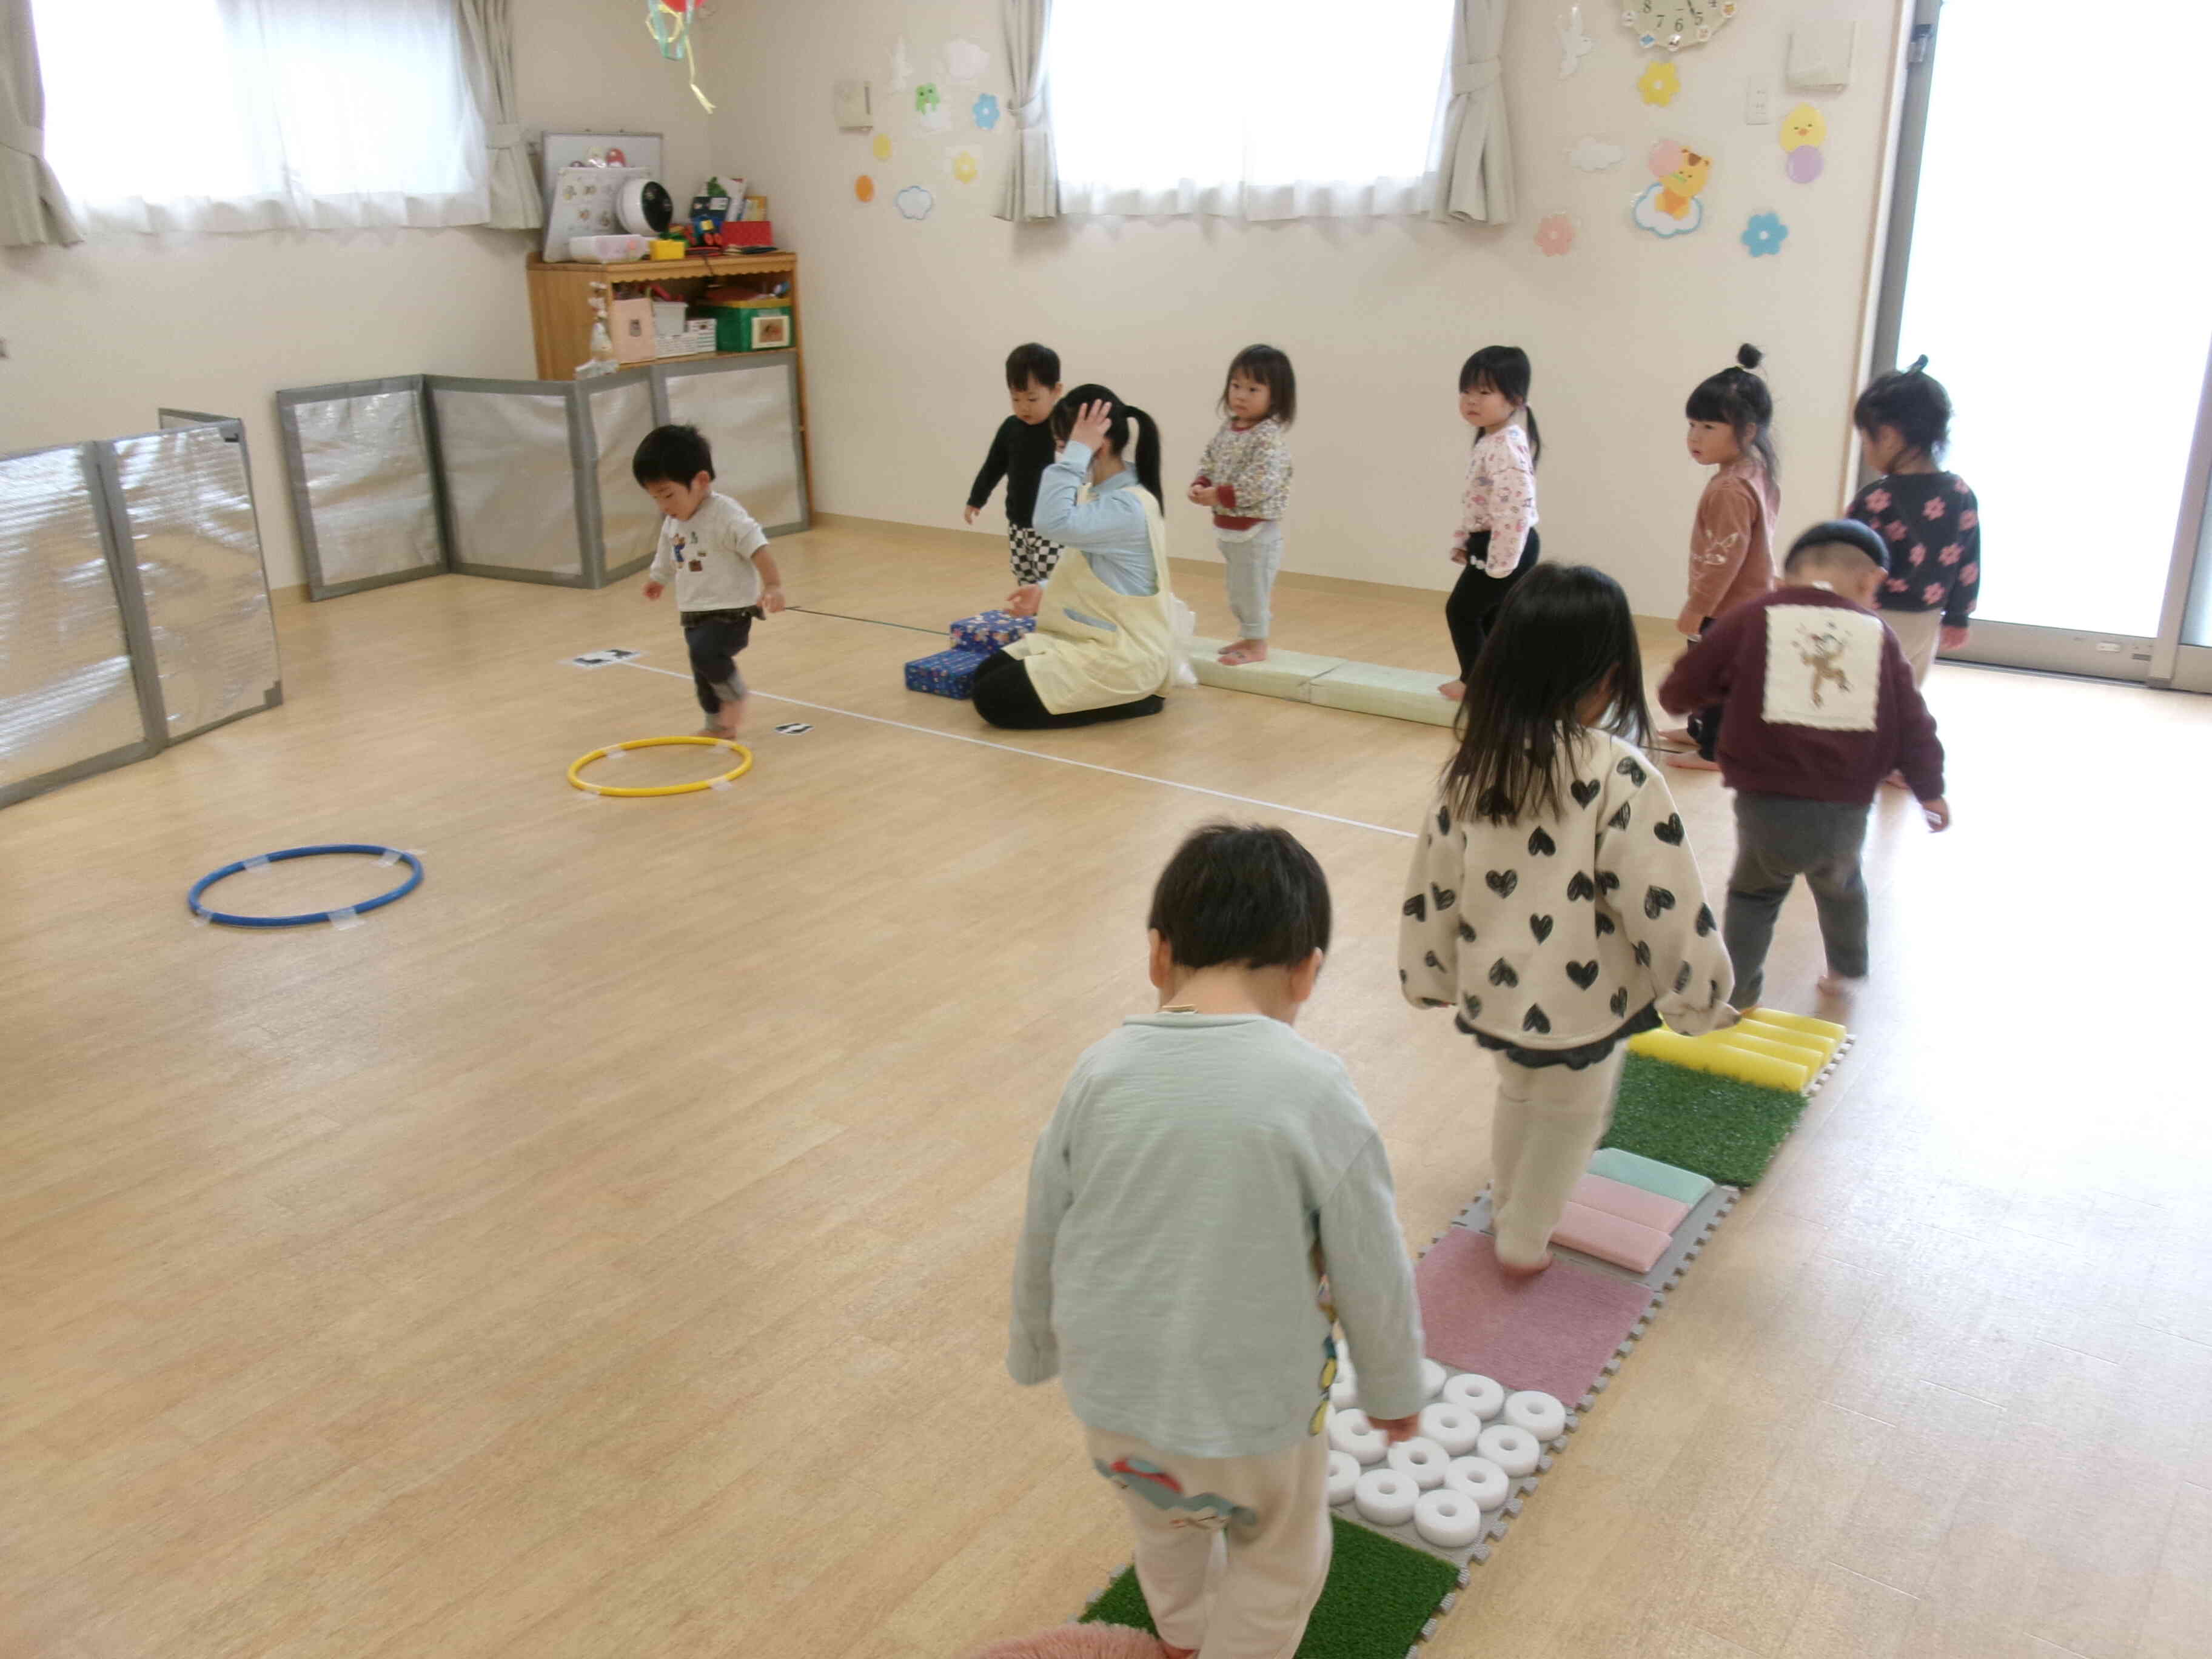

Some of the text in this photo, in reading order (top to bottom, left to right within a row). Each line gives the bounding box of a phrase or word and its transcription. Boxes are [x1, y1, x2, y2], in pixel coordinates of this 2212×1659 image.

[1656, 14, 1665, 28] 7
[1674, 18, 1684, 32] 6
[1694, 12, 1703, 26] 5
